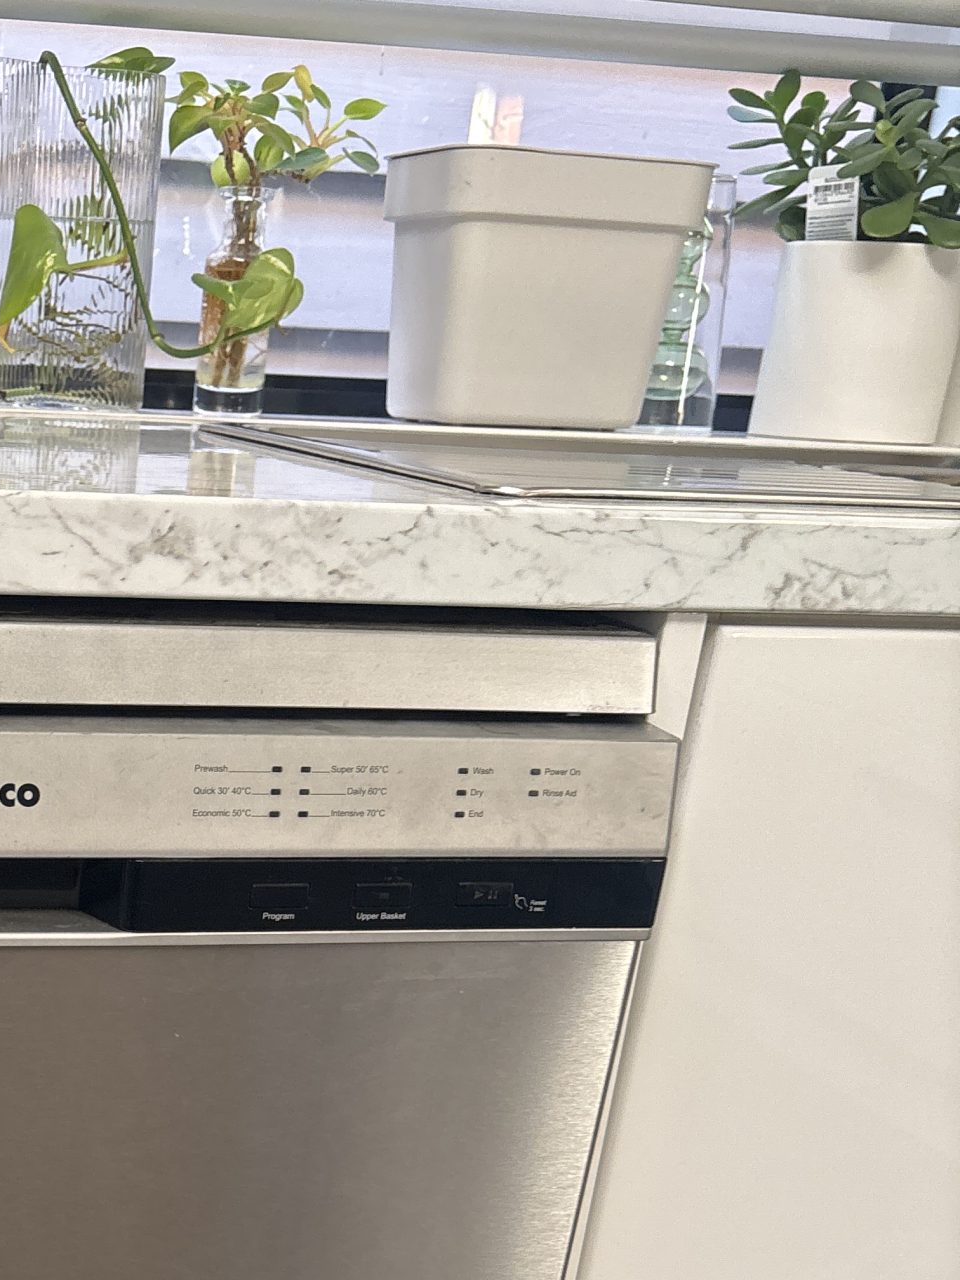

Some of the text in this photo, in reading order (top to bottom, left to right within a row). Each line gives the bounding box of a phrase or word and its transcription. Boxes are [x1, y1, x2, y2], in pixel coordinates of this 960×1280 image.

[194, 764, 229, 773] Prewash
[330, 765, 354, 775] Super
[473, 766, 494, 775] Wash
[544, 767, 581, 776] Power On
[193, 786, 216, 795] Quick
[346, 787, 367, 797] Daily
[470, 788, 484, 798] Dry
[542, 789, 577, 798] Rinse Aid
[192, 808, 230, 818] Economic
[330, 809, 365, 818] Intensive
[468, 810, 484, 819] End
[262, 912, 295, 922] Program
[356, 912, 407, 921] Upper Basket
